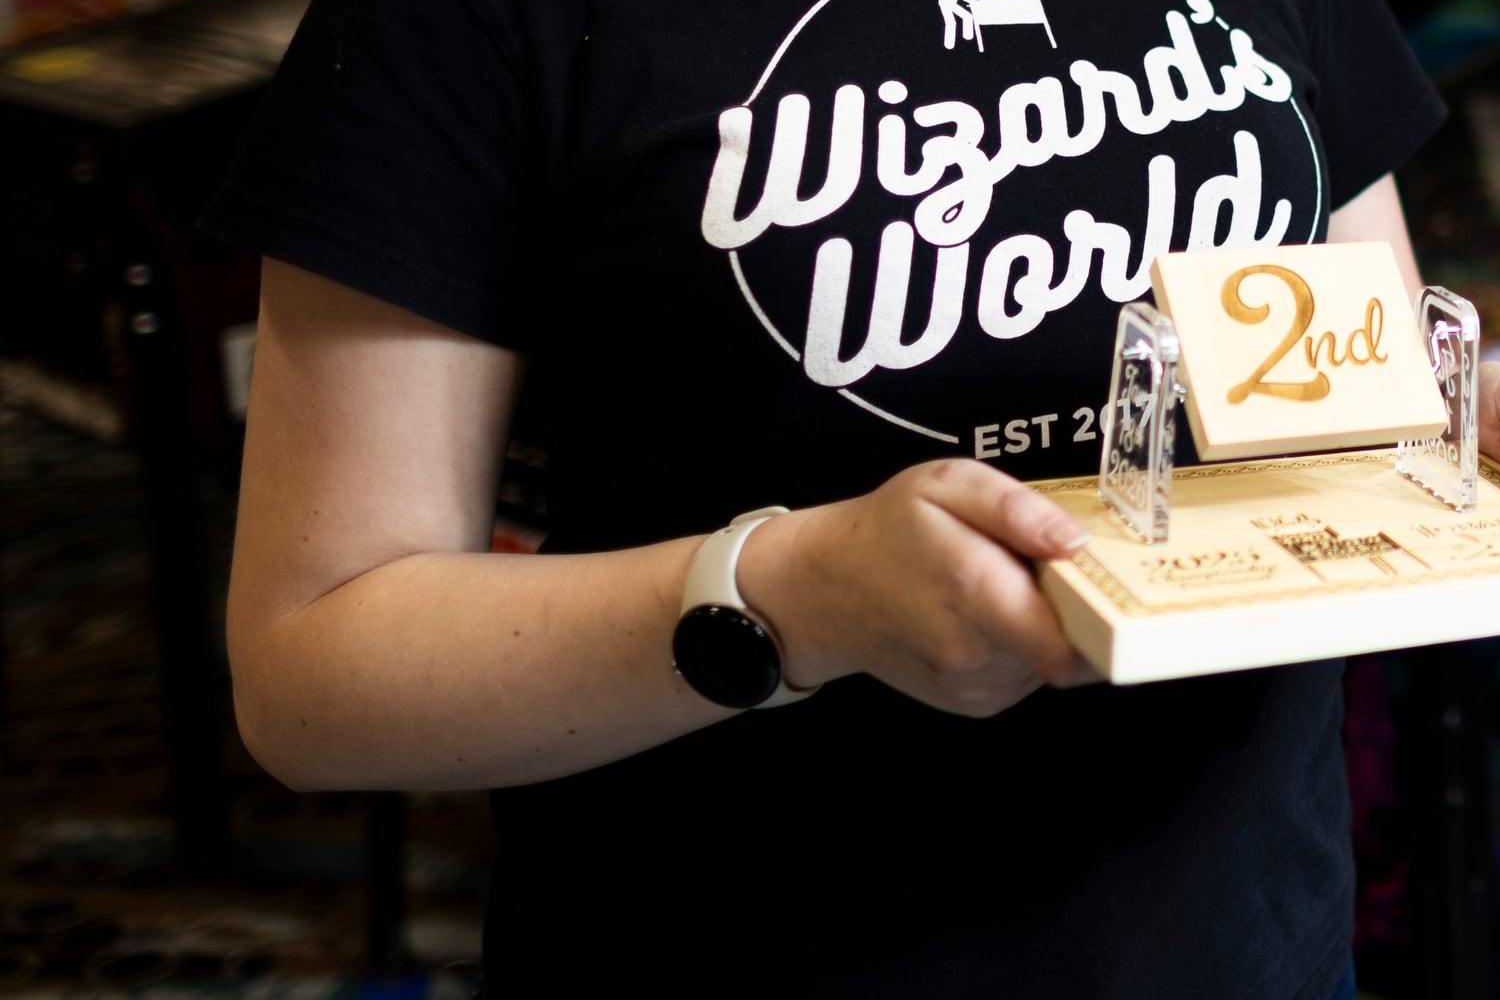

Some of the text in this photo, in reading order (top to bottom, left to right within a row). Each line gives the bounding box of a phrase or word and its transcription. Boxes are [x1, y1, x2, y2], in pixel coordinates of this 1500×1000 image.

[804, 130, 1292, 388] World
[1221, 264, 1388, 405] 2nd
[975, 413, 1058, 460] EST
